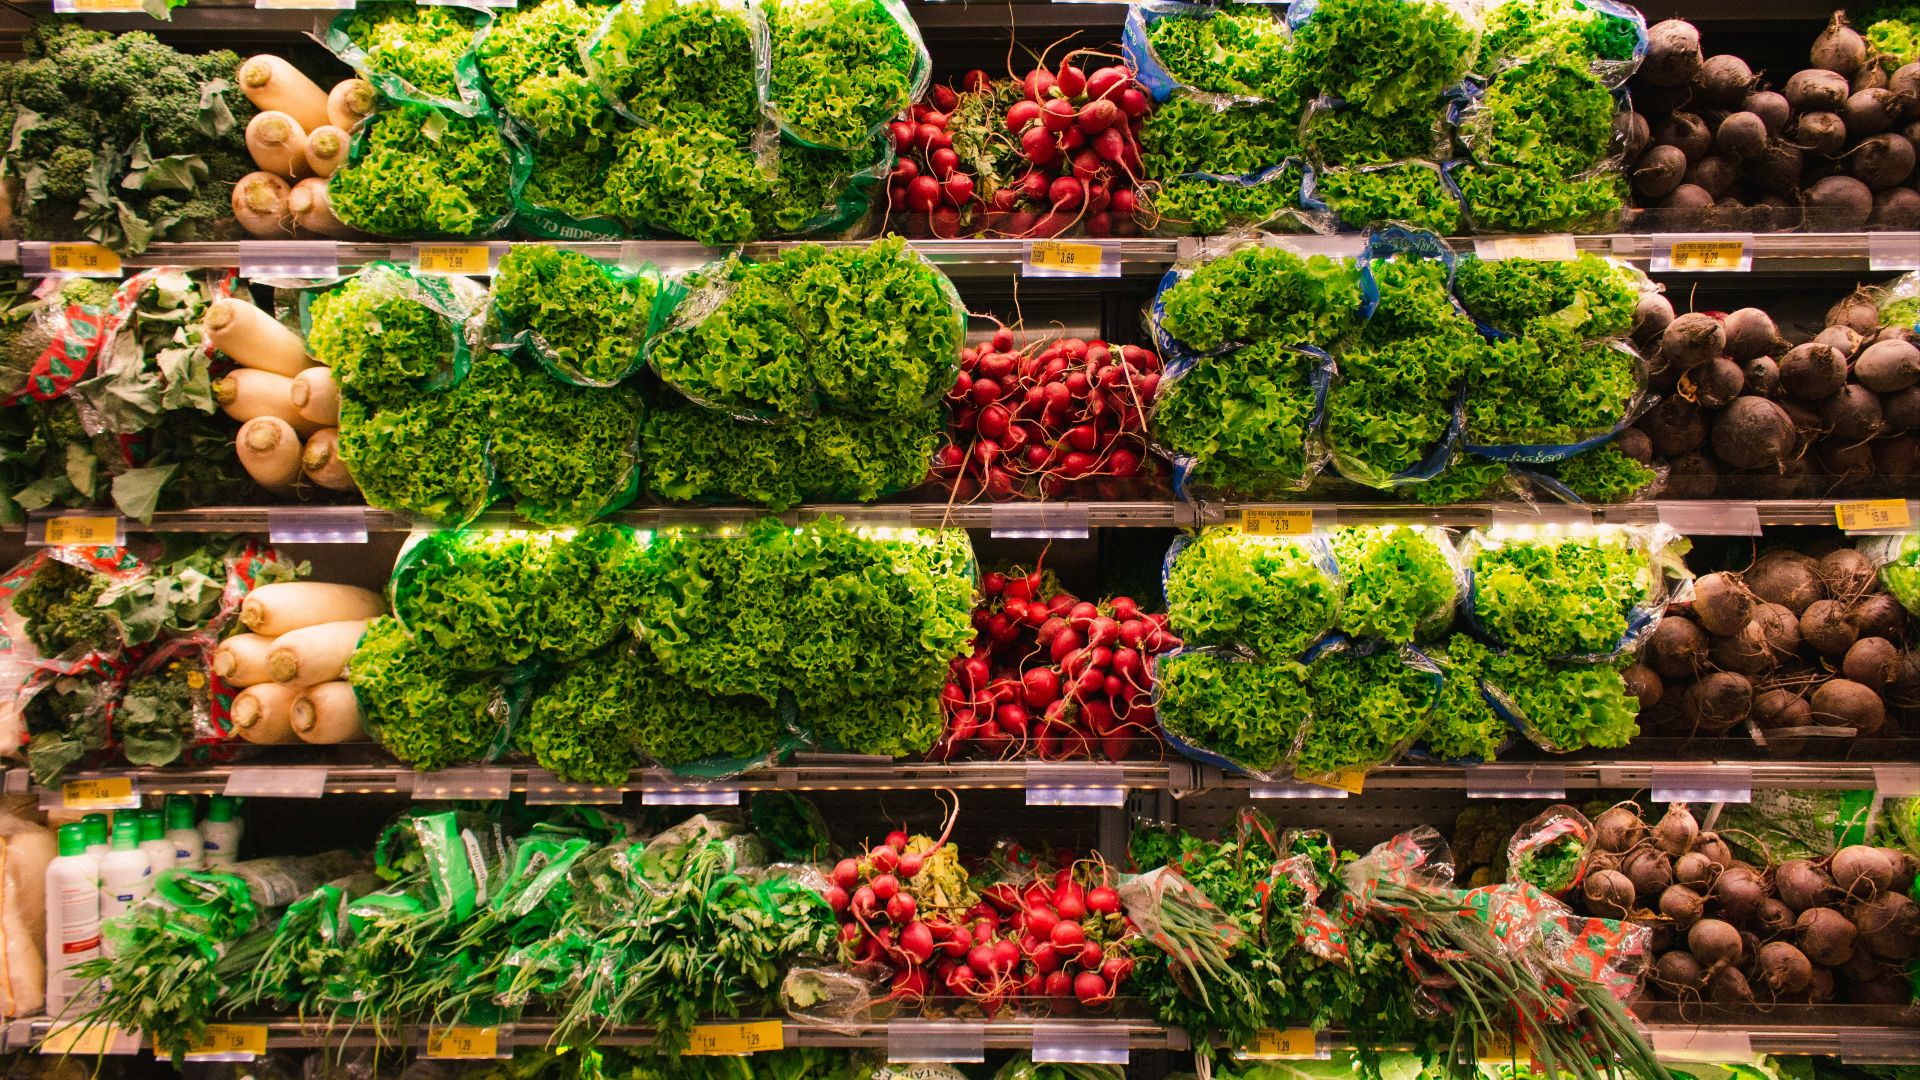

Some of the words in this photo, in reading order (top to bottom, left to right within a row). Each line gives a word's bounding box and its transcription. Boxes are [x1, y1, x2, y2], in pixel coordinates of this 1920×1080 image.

[449, 256, 463, 268] 2,99
[1060, 252, 1075, 264] 3,69
[1703, 252, 1719, 264] 2,79
[1275, 519, 1289, 532] 2,79
[1277, 1040, 1290, 1053] 1,29
